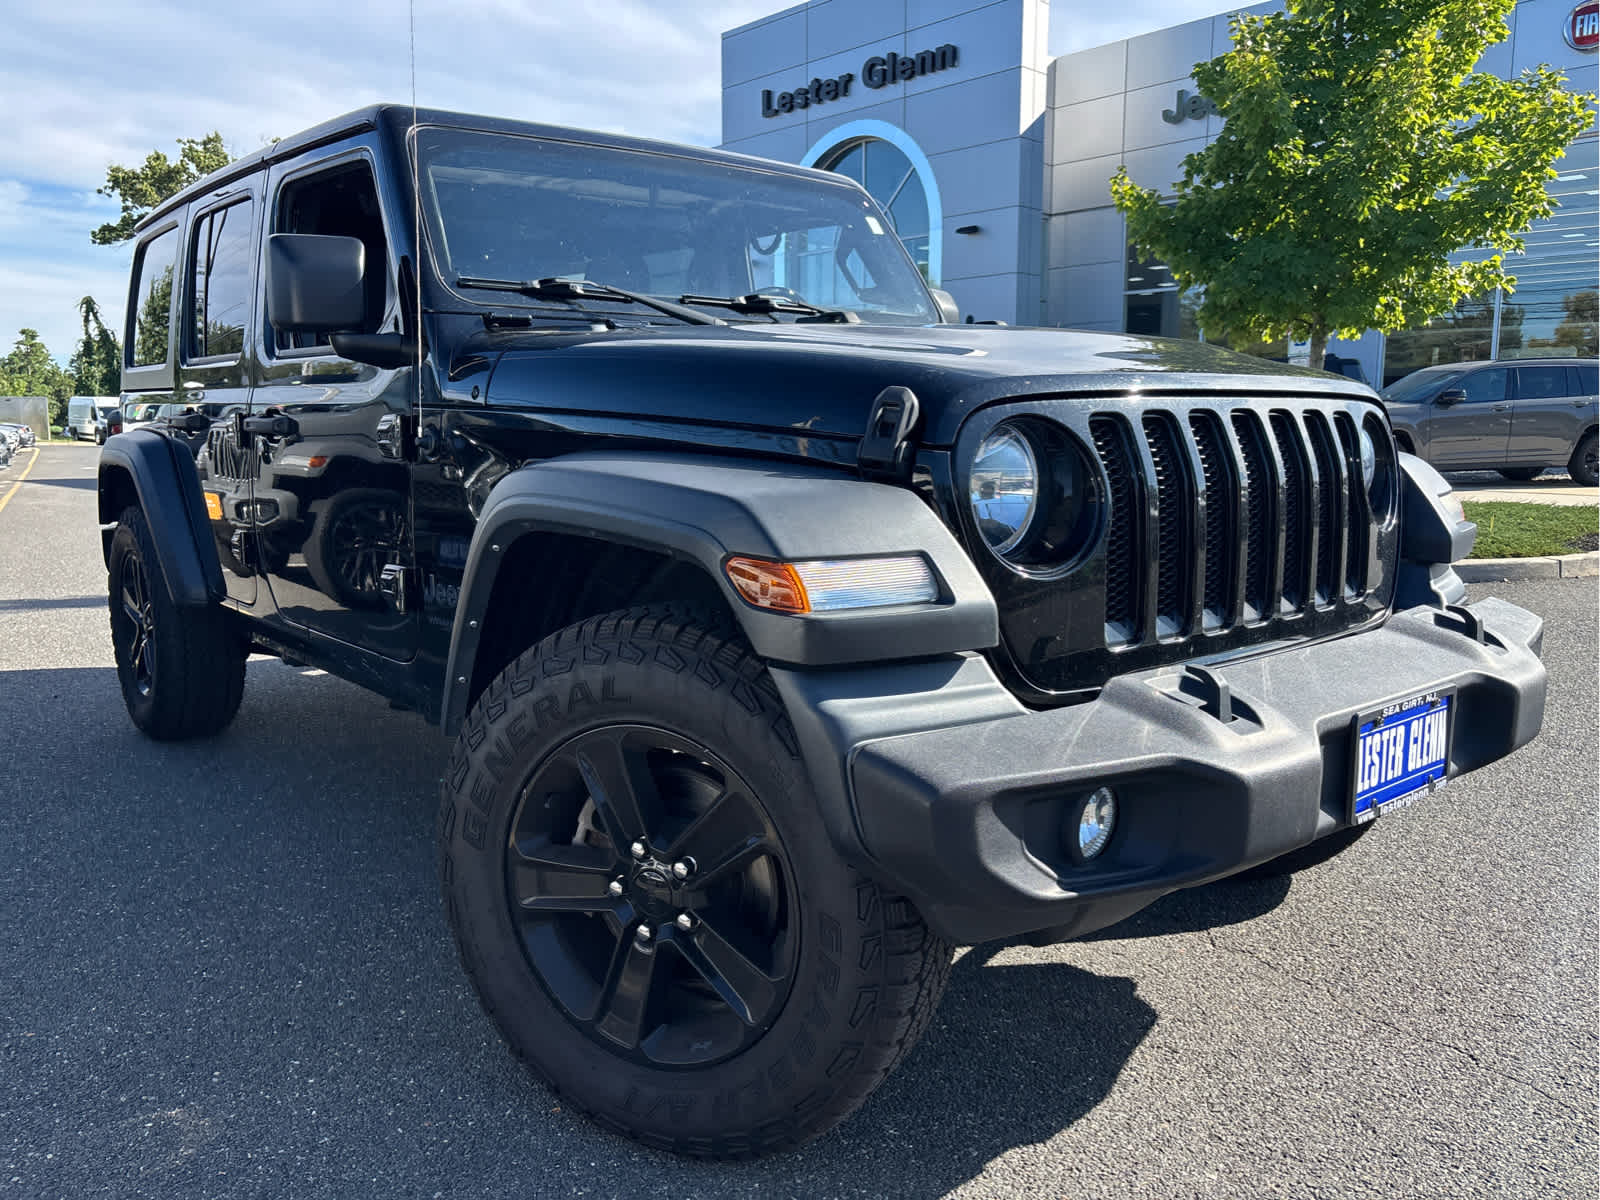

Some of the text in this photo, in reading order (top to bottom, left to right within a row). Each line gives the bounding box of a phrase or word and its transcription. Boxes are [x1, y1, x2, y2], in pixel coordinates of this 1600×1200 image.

[1575, 12, 1599, 37] FIA
[761, 43, 959, 119] Lester Glenn
[1162, 89, 1220, 125] Jee
[424, 573, 461, 608] Jee
[1382, 704, 1400, 717] SEA
[1402, 697, 1424, 711] GIRT,
[462, 675, 632, 850] GENERAL
[1357, 709, 1448, 794] LESTER GLENN
